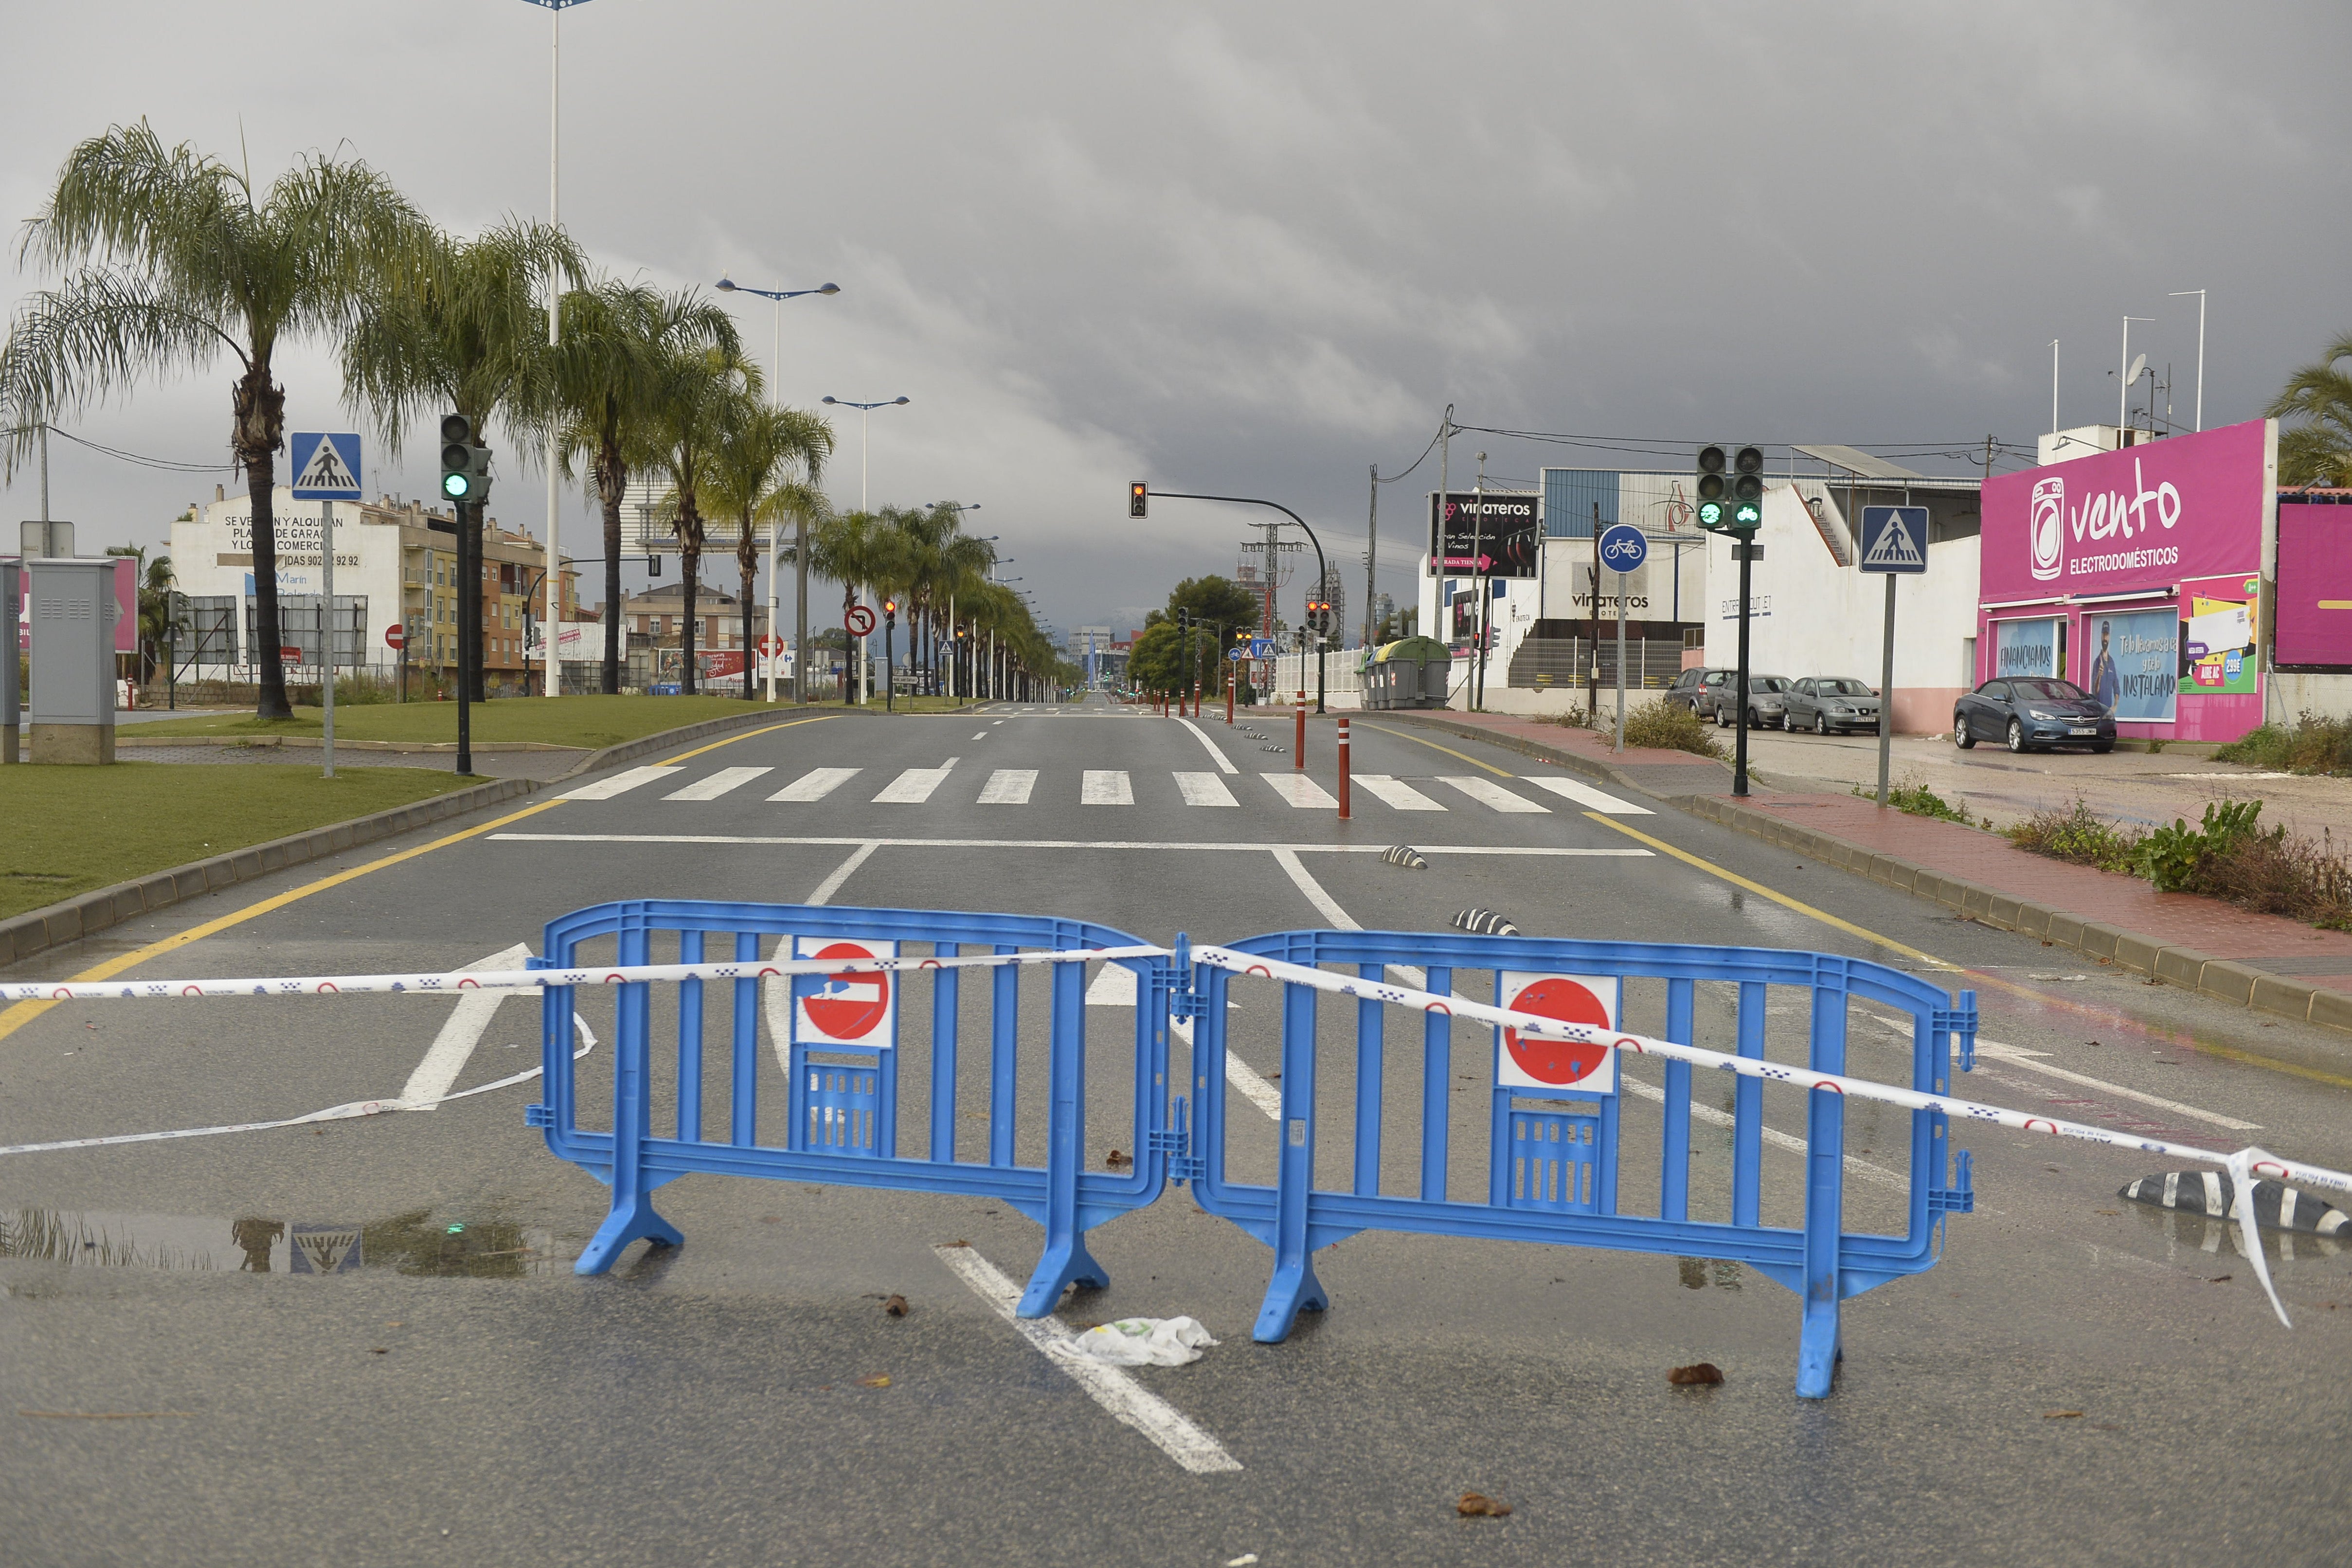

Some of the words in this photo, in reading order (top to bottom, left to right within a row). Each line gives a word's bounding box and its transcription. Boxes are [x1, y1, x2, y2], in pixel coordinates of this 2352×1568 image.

[2071, 457, 2181, 543] vento
[225, 517, 237, 526] SE
[239, 517, 281, 526] VEN
[283, 517, 291, 526] Y
[292, 517, 343, 527] ALQUIAN
[233, 528, 252, 538] PLA
[275, 529, 288, 539] DE
[291, 529, 323, 539] GARA
[277, 541, 336, 551] COMERCI
[1448, 541, 1469, 549] Vinos
[307, 556, 322, 565] 902
[337, 556, 346, 565] 92
[348, 556, 359, 566] 92
[2070, 546, 2178, 575] ELECTRODOMÉSTICOS
[2136, 634, 2163, 654] llevamos
[2165, 641, 2169, 652] a
[2000, 645, 2051, 669] FINANCIAMOS
